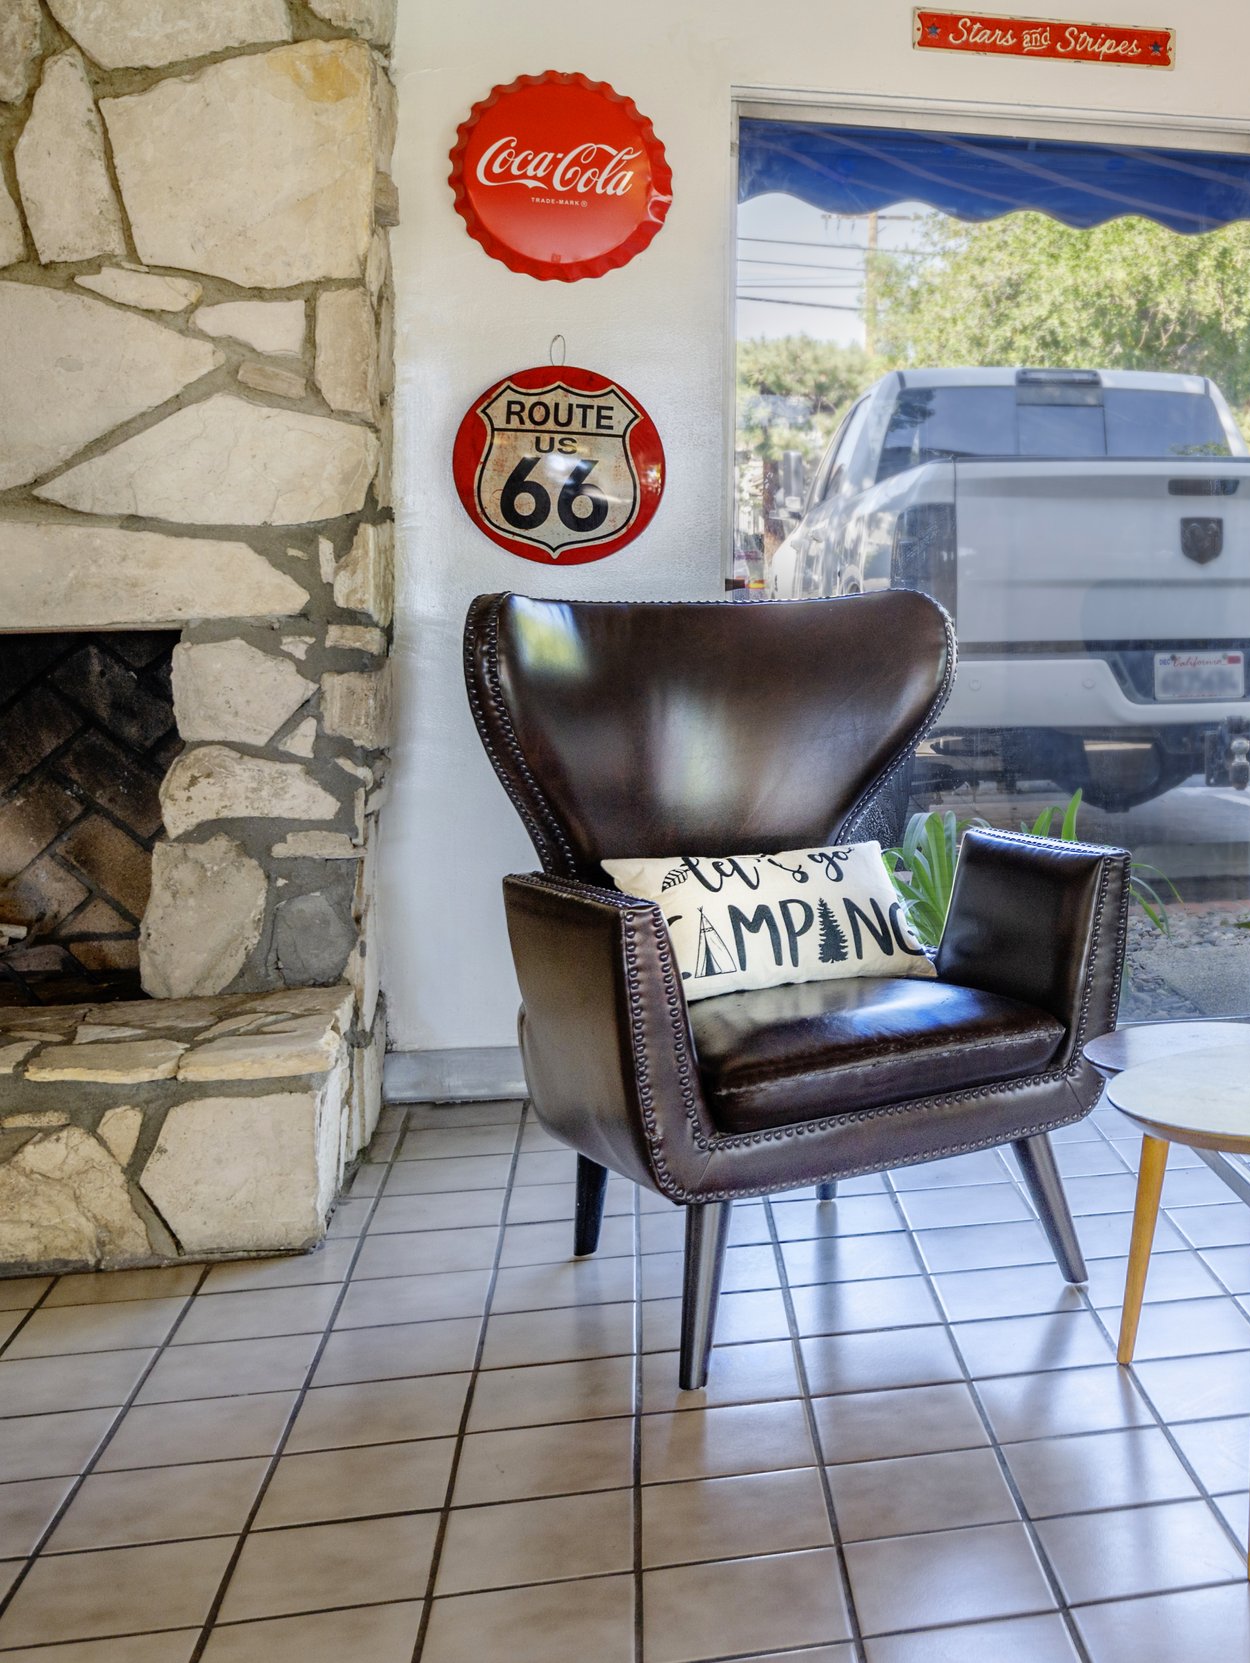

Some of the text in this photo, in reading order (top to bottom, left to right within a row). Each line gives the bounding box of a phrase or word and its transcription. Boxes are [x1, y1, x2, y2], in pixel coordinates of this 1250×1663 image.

[949, 18, 1142, 60] Stars and Stripes
[476, 136, 643, 196] Coca-Cola
[531, 197, 579, 206] TRADE-MARK
[505, 400, 614, 430] ROUTE
[534, 436, 577, 454] US
[500, 456, 609, 532] 66
[808, 847, 855, 883] go
